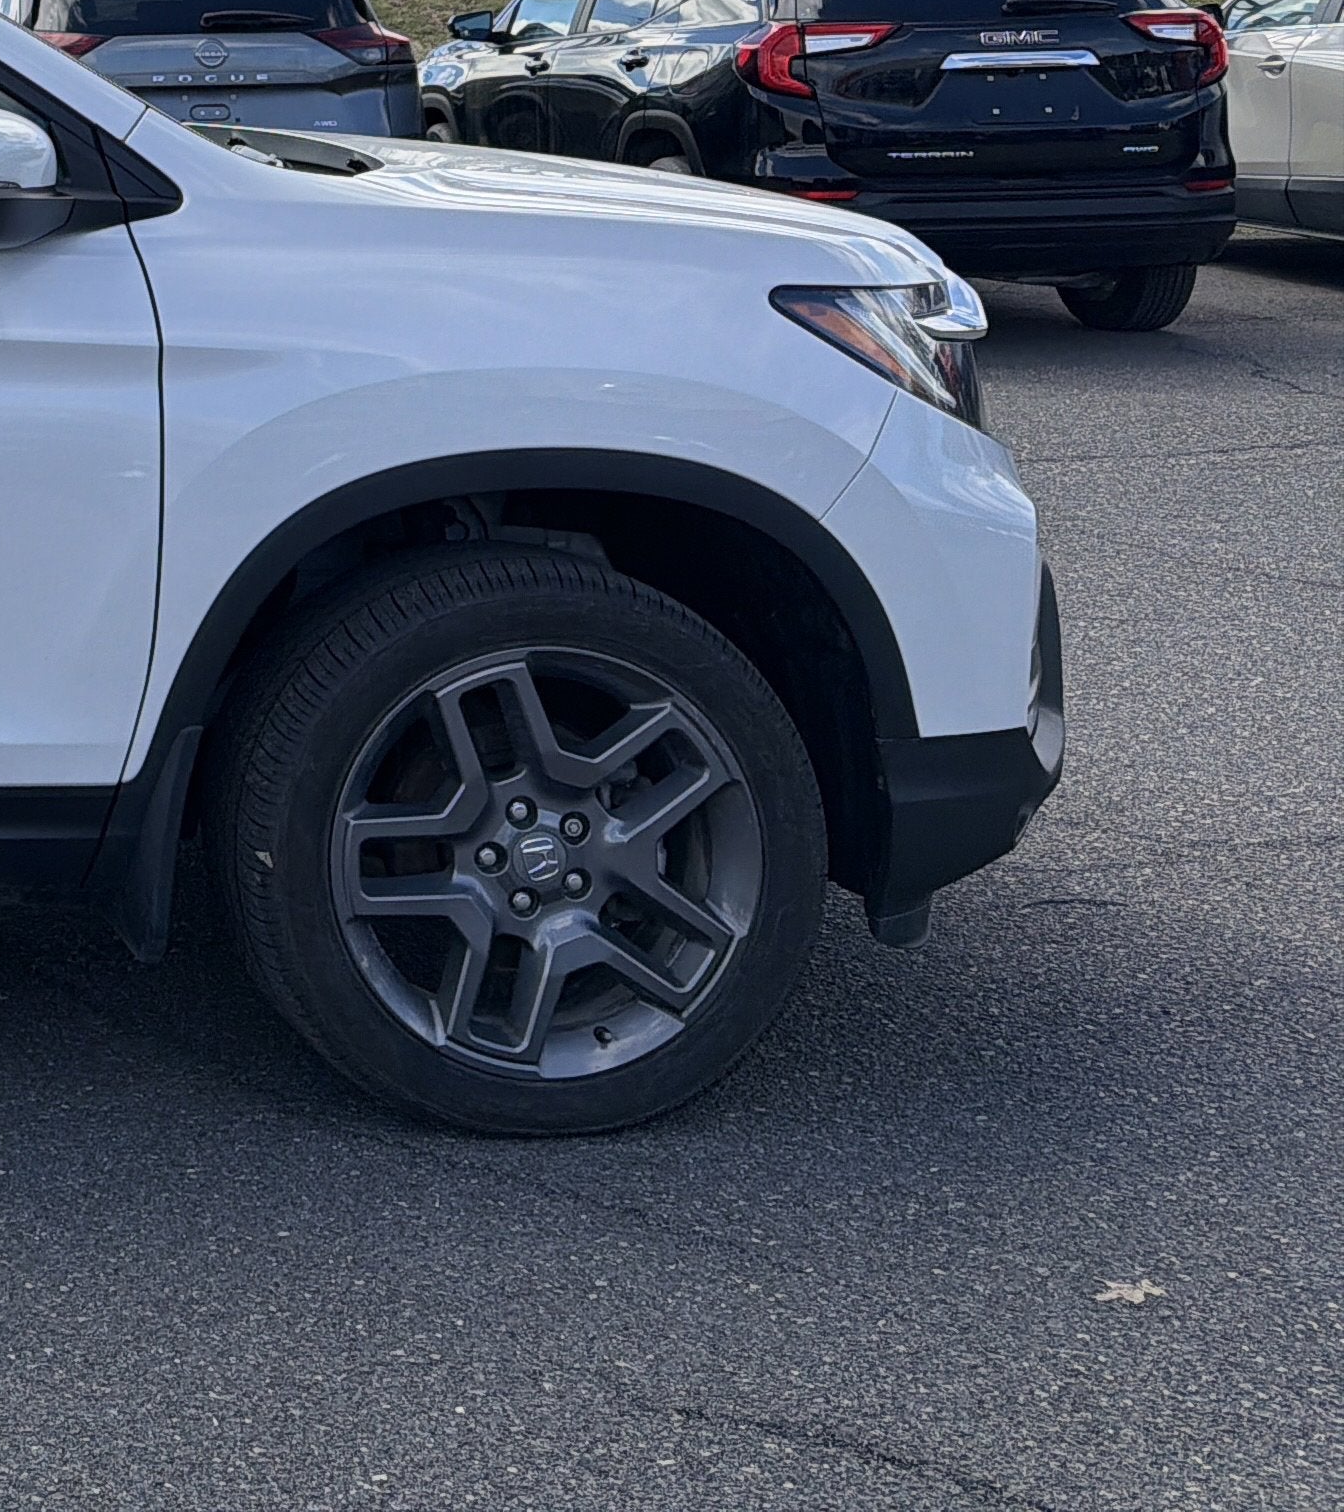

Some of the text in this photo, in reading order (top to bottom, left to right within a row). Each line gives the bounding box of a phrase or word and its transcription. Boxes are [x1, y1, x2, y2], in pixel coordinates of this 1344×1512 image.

[980, 29, 1060, 46] GMC
[152, 72, 269, 83] ROGUE
[1122, 144, 1159, 153] AWD
[887, 150, 975, 160] TERRAIN
